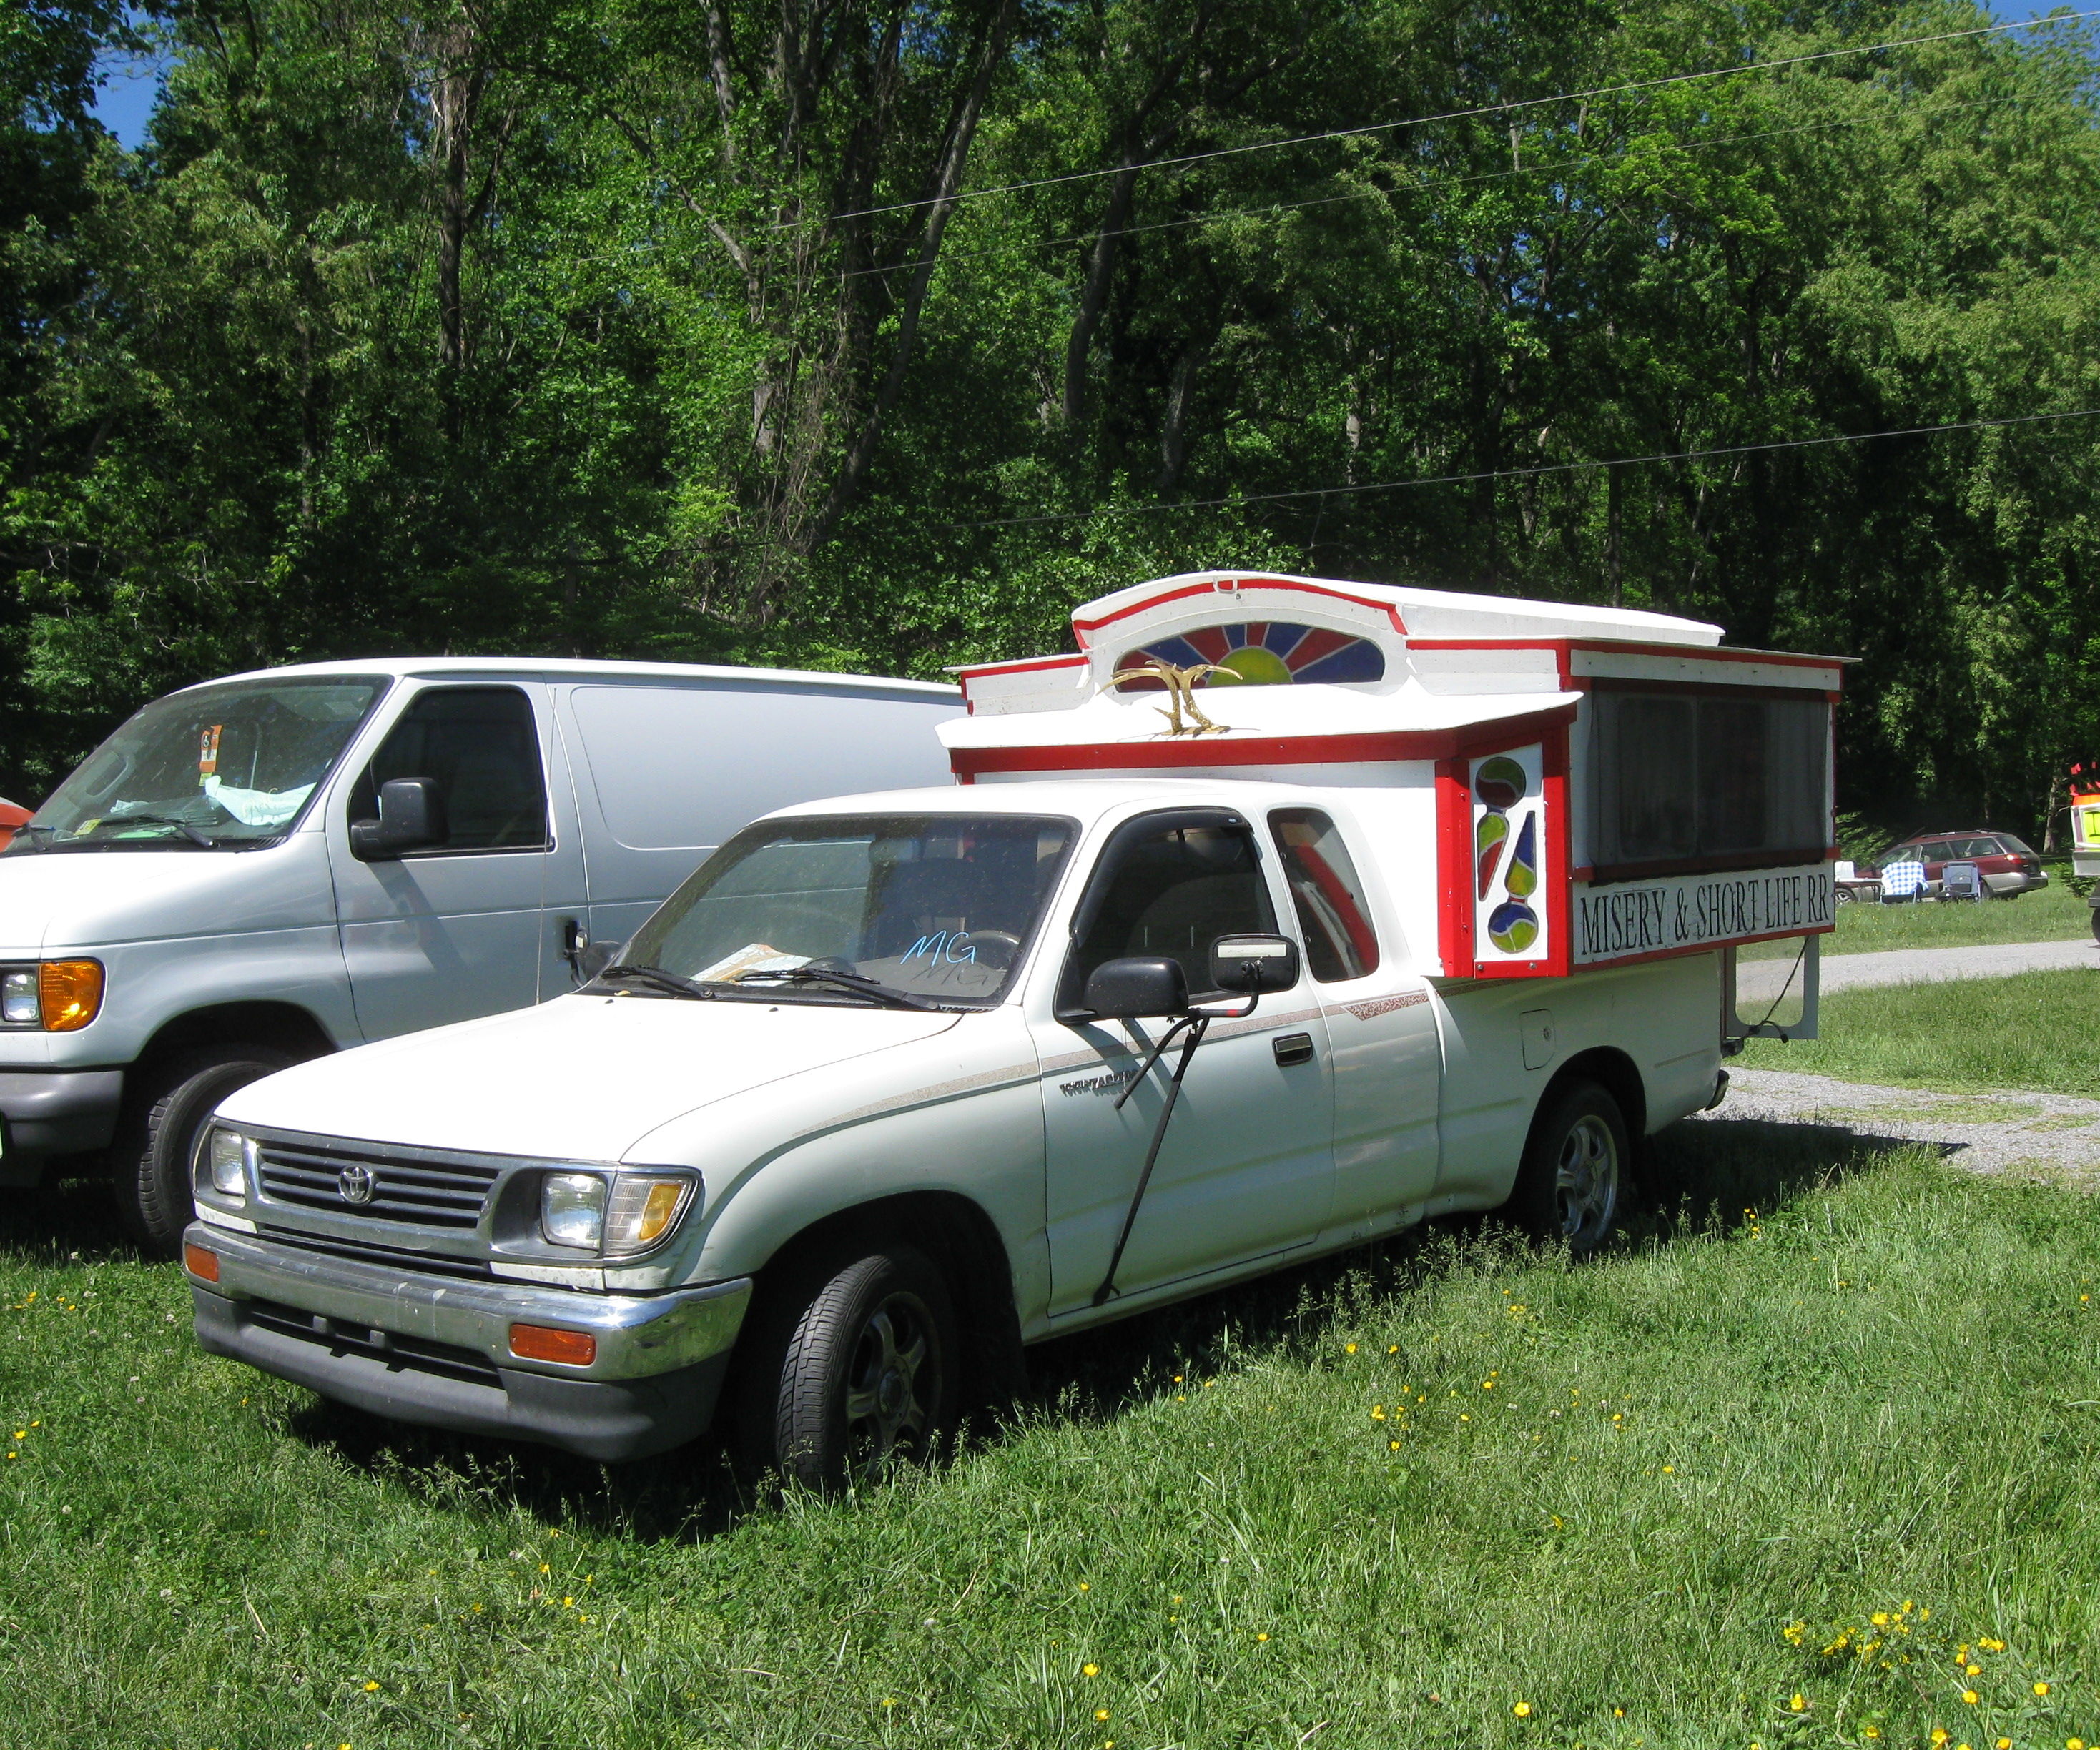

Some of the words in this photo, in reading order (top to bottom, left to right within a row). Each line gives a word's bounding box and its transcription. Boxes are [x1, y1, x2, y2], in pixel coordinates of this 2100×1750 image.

[1580, 890, 1667, 956] MISERY
[1675, 888, 1690, 941] &
[1696, 879, 1760, 938] SHORT
[1764, 876, 1801, 929] LIFE
[1807, 874, 1830, 922] RR
[900, 930, 976, 967] MG
